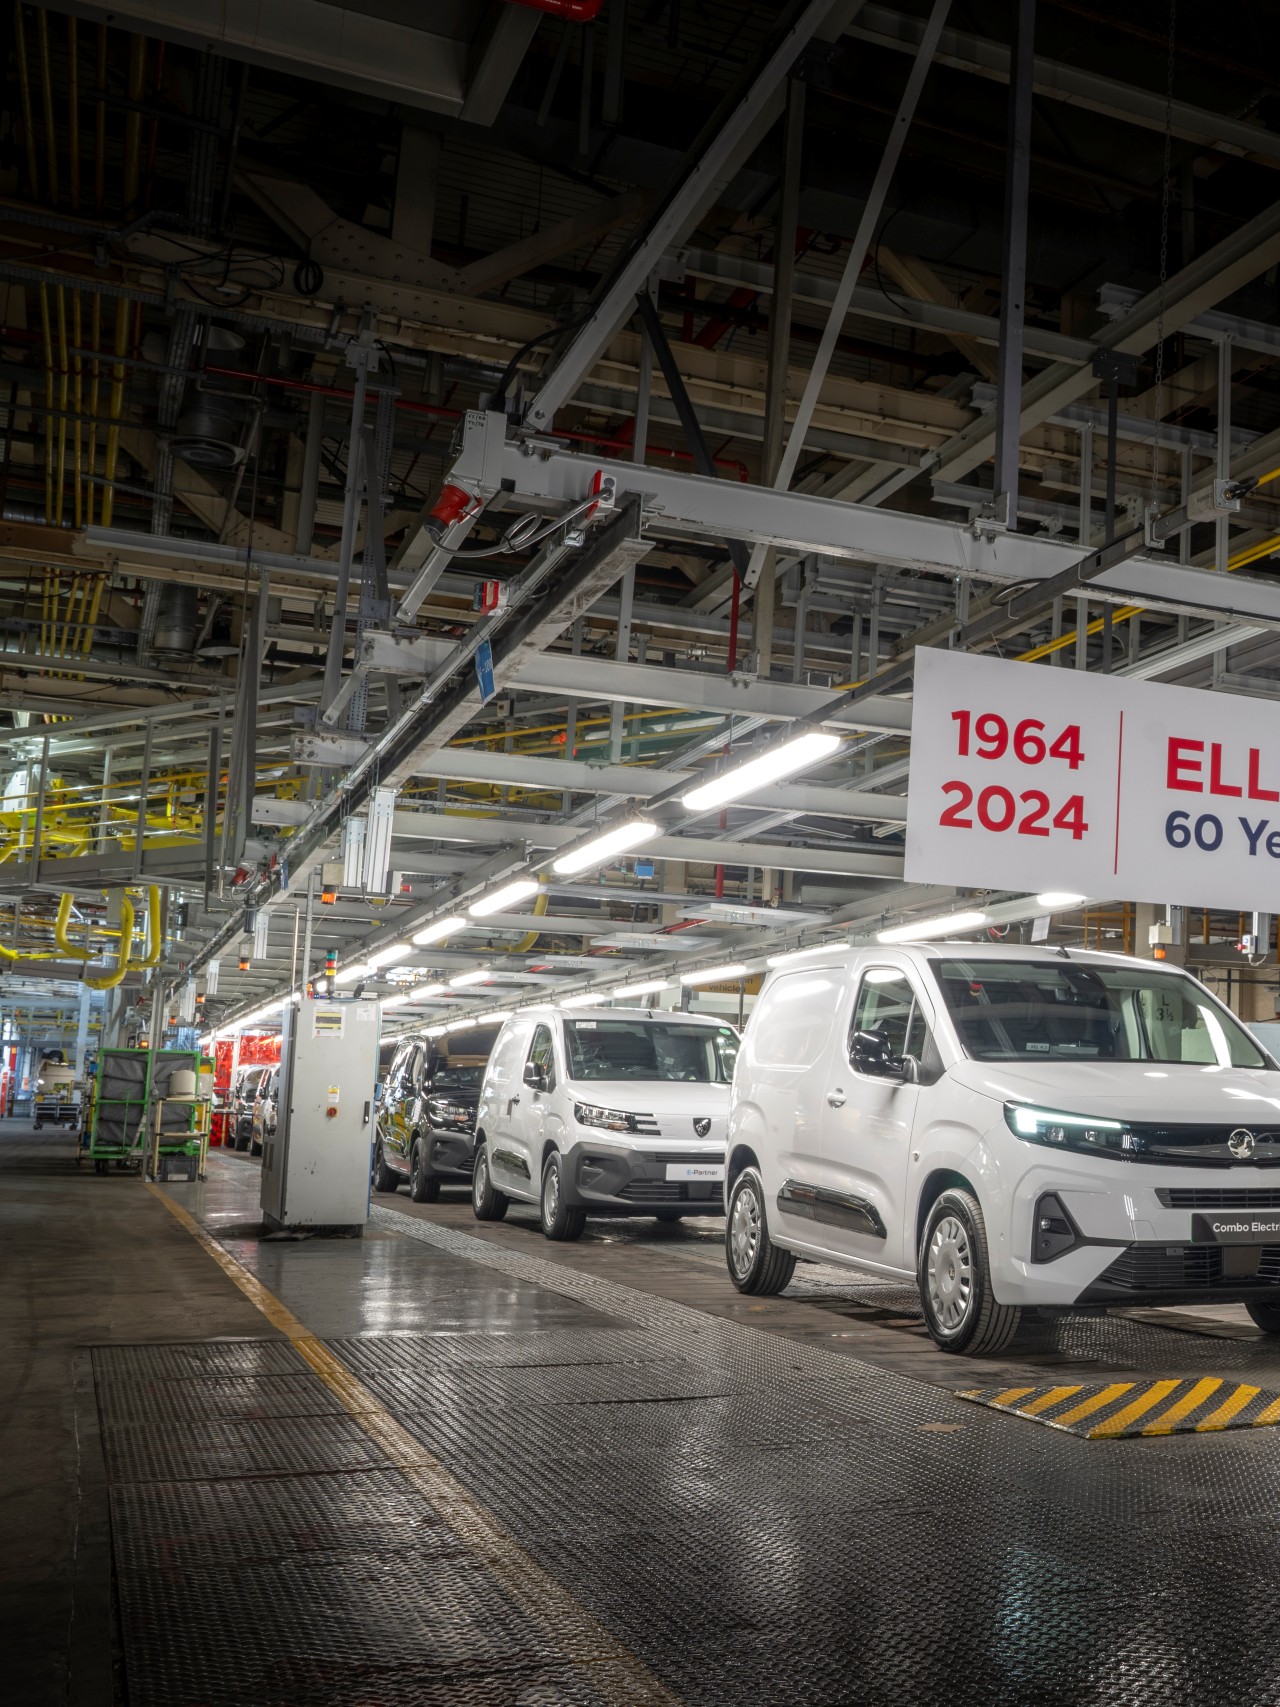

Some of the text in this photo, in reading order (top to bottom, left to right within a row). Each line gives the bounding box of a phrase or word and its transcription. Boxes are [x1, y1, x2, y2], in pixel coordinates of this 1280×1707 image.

[952, 710, 1085, 769] 1964
[940, 781, 1089, 840] 2024
[1166, 811, 1223, 851] 60
[1213, 1222, 1249, 1232] Combo
